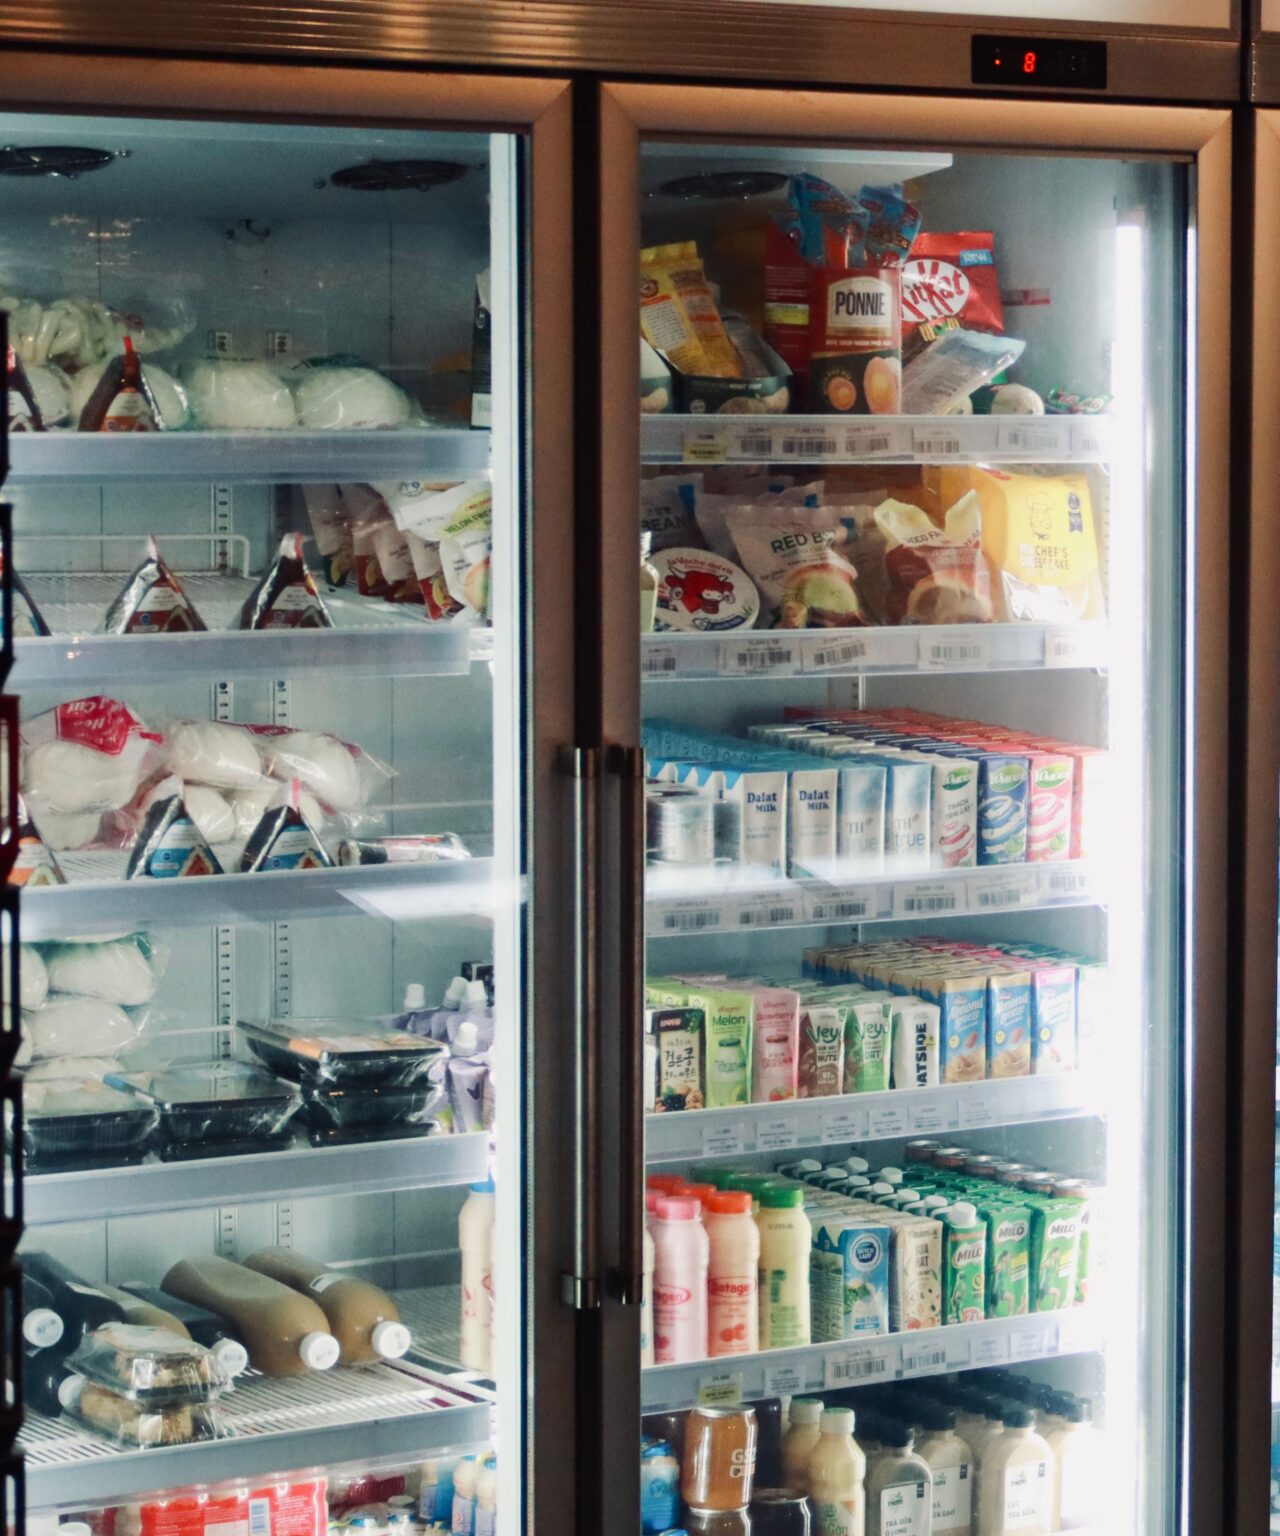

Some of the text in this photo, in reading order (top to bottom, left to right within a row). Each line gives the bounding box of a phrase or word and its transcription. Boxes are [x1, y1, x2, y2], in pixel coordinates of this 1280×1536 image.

[1022, 52, 1037, 73] 8
[746, 792, 778, 804] Dalat
[799, 789, 830, 801] Dalat
[755, 803, 777, 813] Milk
[807, 800, 830, 811] Milk
[712, 1015, 746, 1027] Melon
[807, 1025, 843, 1044] Vey
[998, 1226, 1025, 1238] MILO
[1050, 1222, 1076, 1235] MILO
[957, 1247, 983, 1262] MILO
